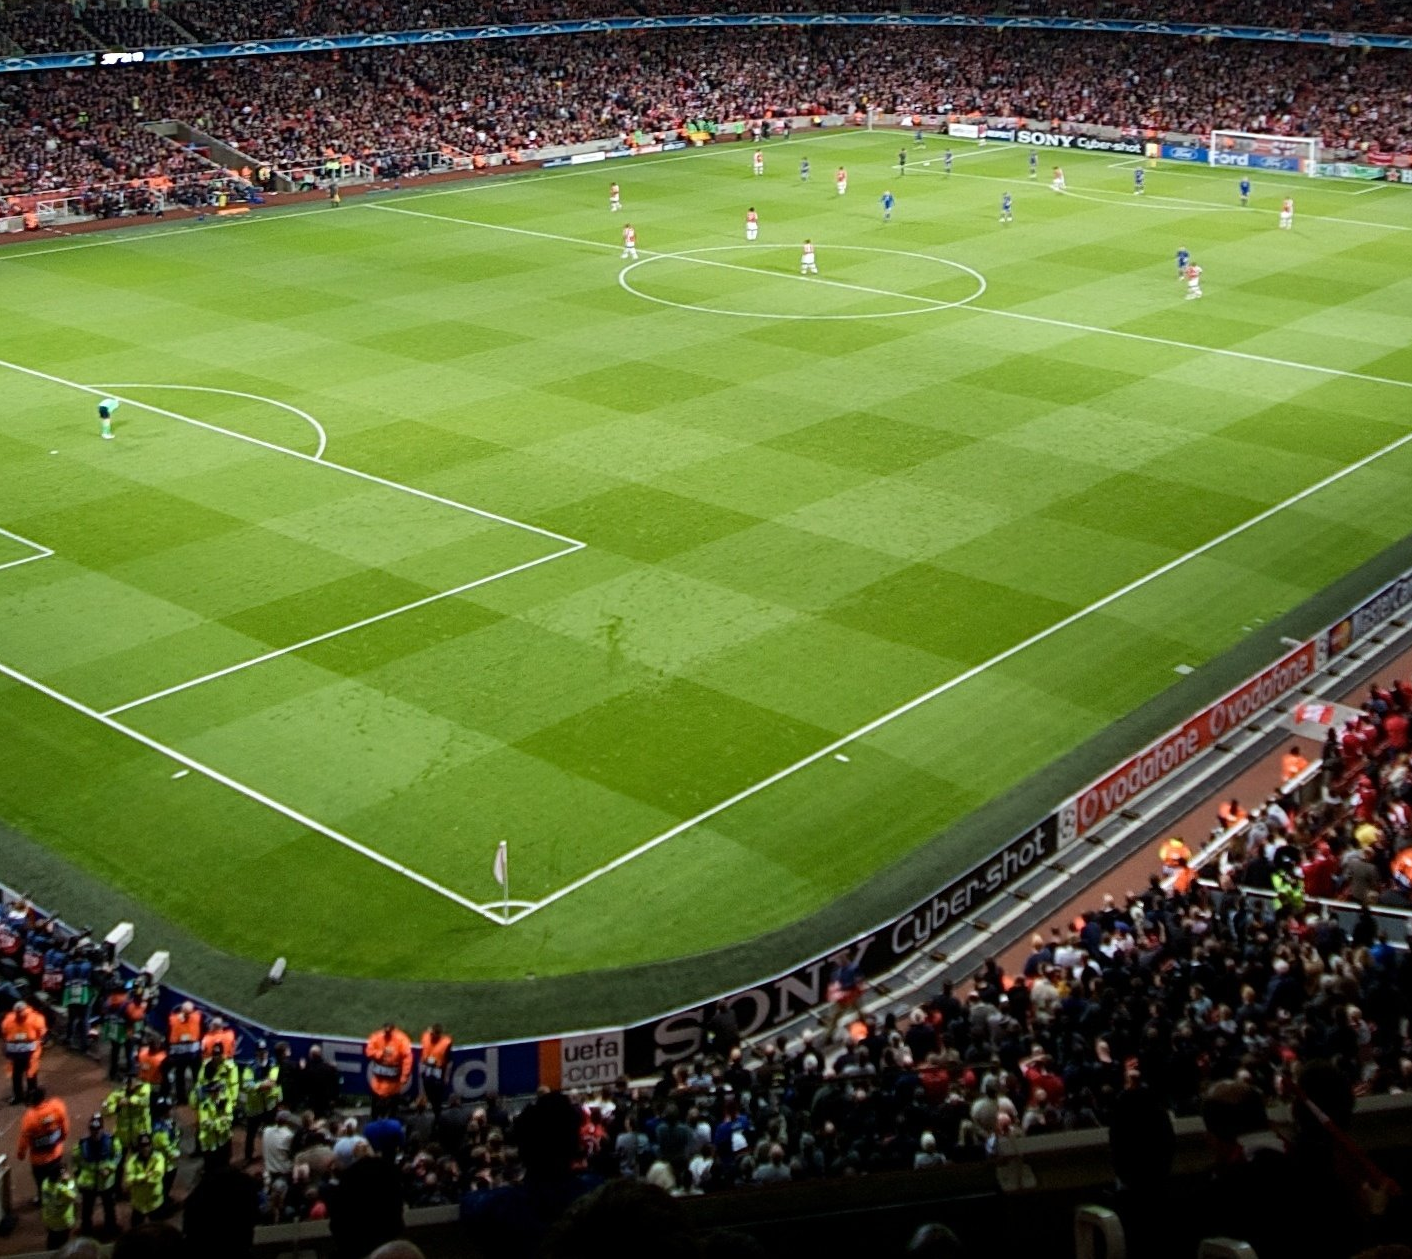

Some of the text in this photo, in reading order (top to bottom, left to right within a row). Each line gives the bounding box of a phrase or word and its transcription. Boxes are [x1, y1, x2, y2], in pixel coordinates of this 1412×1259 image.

[1017, 129, 1075, 148] SONY
[1077, 136, 1142, 154] Cyber-shot
[1208, 150, 1249, 166] Ford
[1228, 652, 1309, 726] vodafone
[1098, 727, 1200, 813] vodafone
[653, 825, 1047, 1068] SONY Cyber-shot
[322, 1040, 500, 1100] Fd
[564, 1037, 619, 1063] uefa
